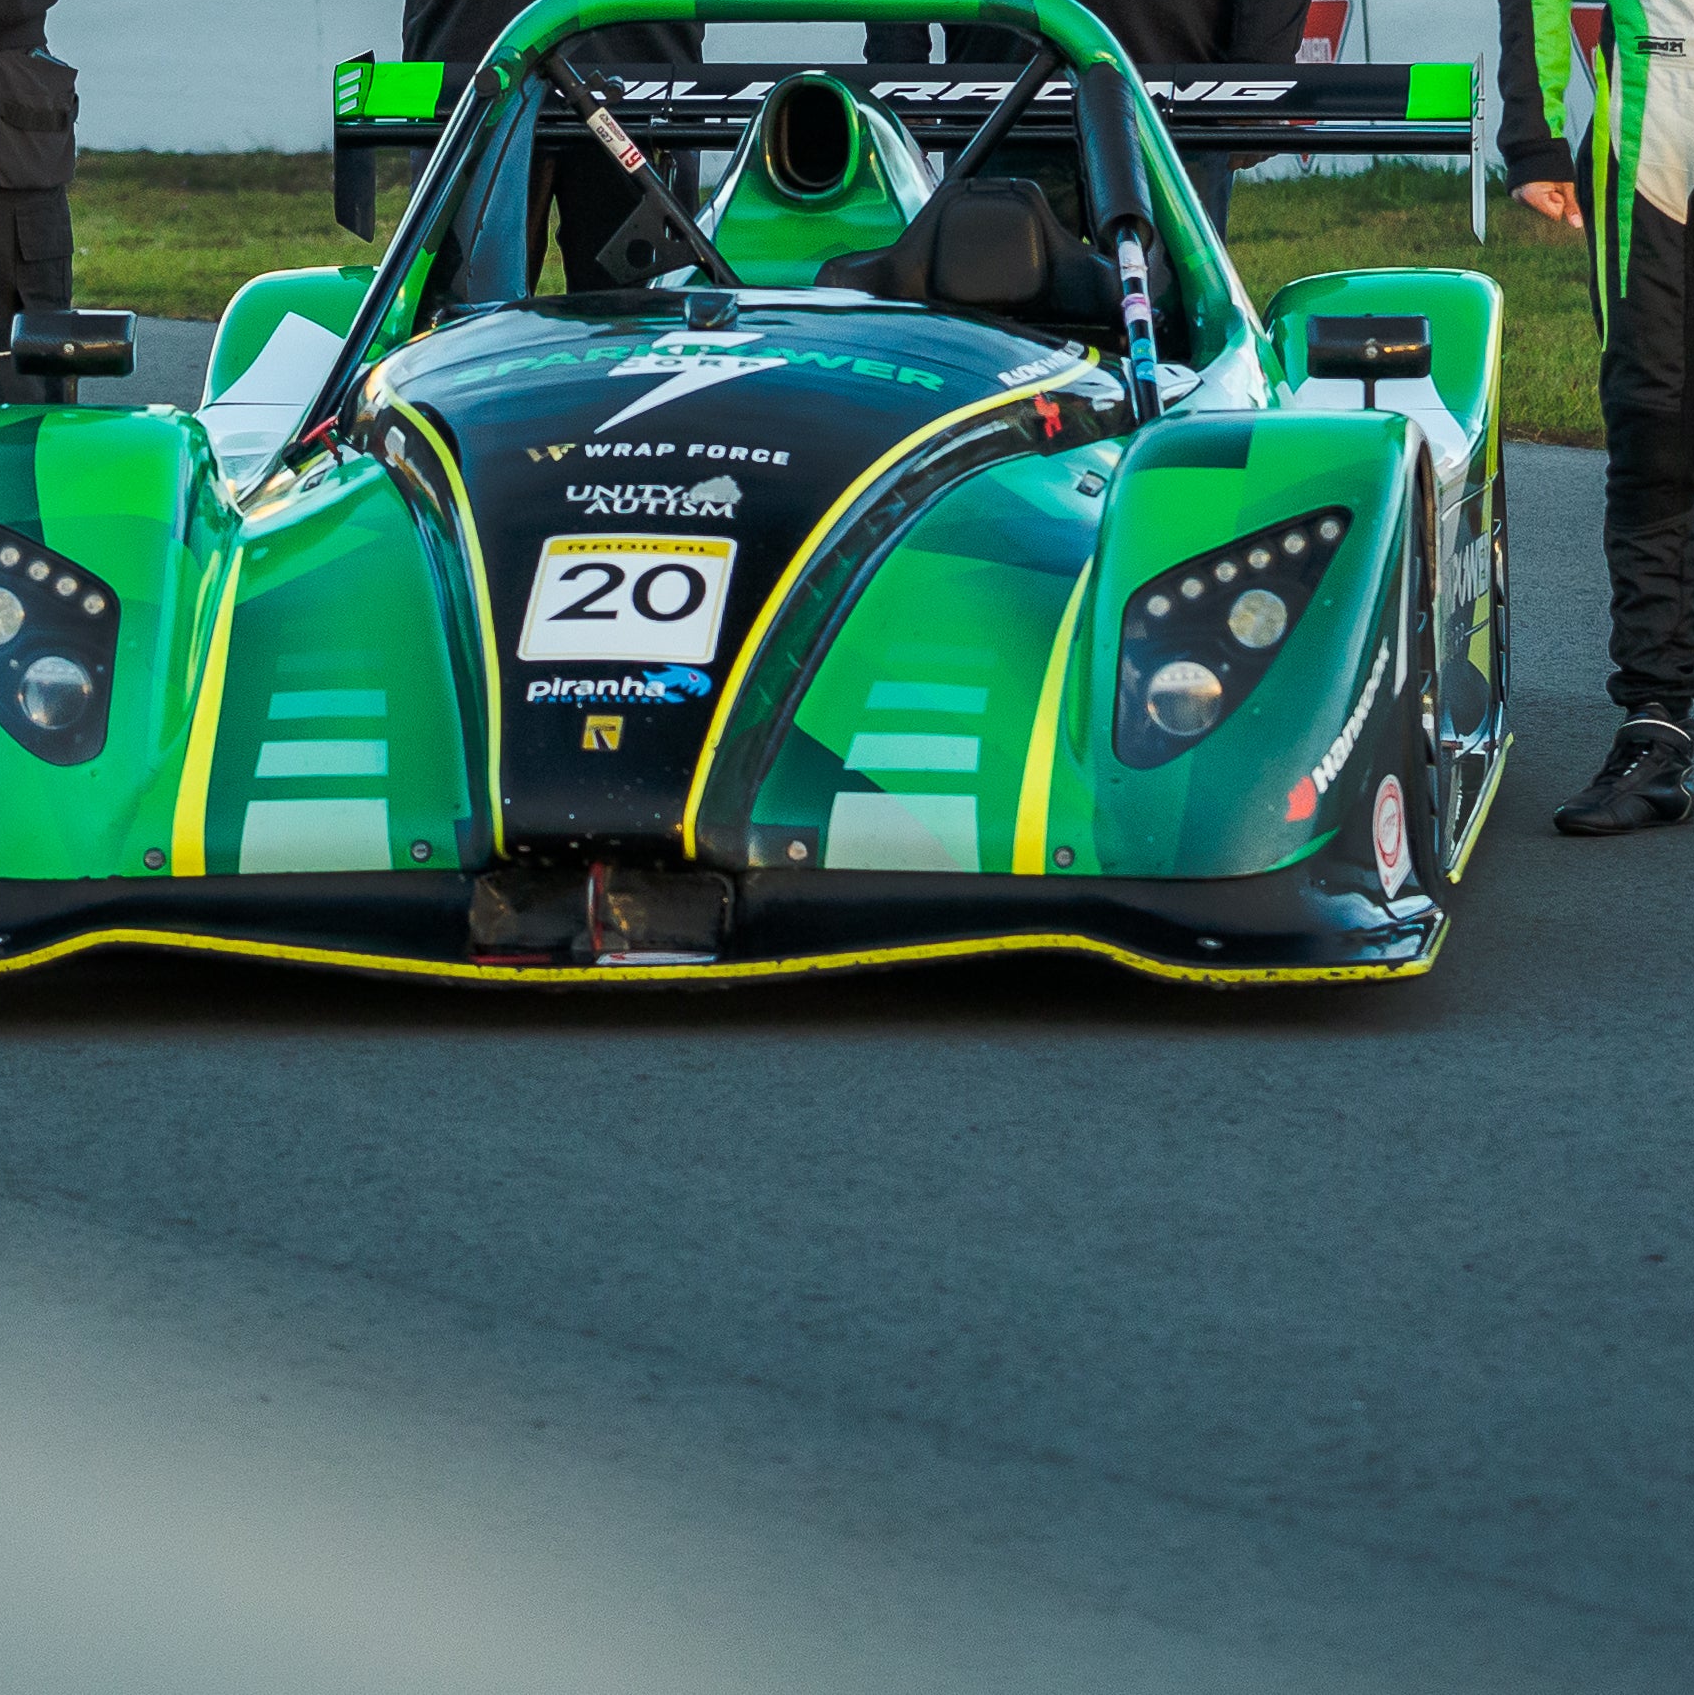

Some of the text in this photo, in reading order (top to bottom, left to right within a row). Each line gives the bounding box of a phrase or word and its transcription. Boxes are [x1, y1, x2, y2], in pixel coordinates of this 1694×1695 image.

[868, 80, 1299, 102] RACNG
[584, 442, 677, 459] WRAP
[686, 443, 791, 467] FORCE
[565, 484, 686, 502] UNITY
[583, 498, 737, 520] AUTISM
[546, 562, 708, 623] 20
[525, 675, 668, 703] piranha
